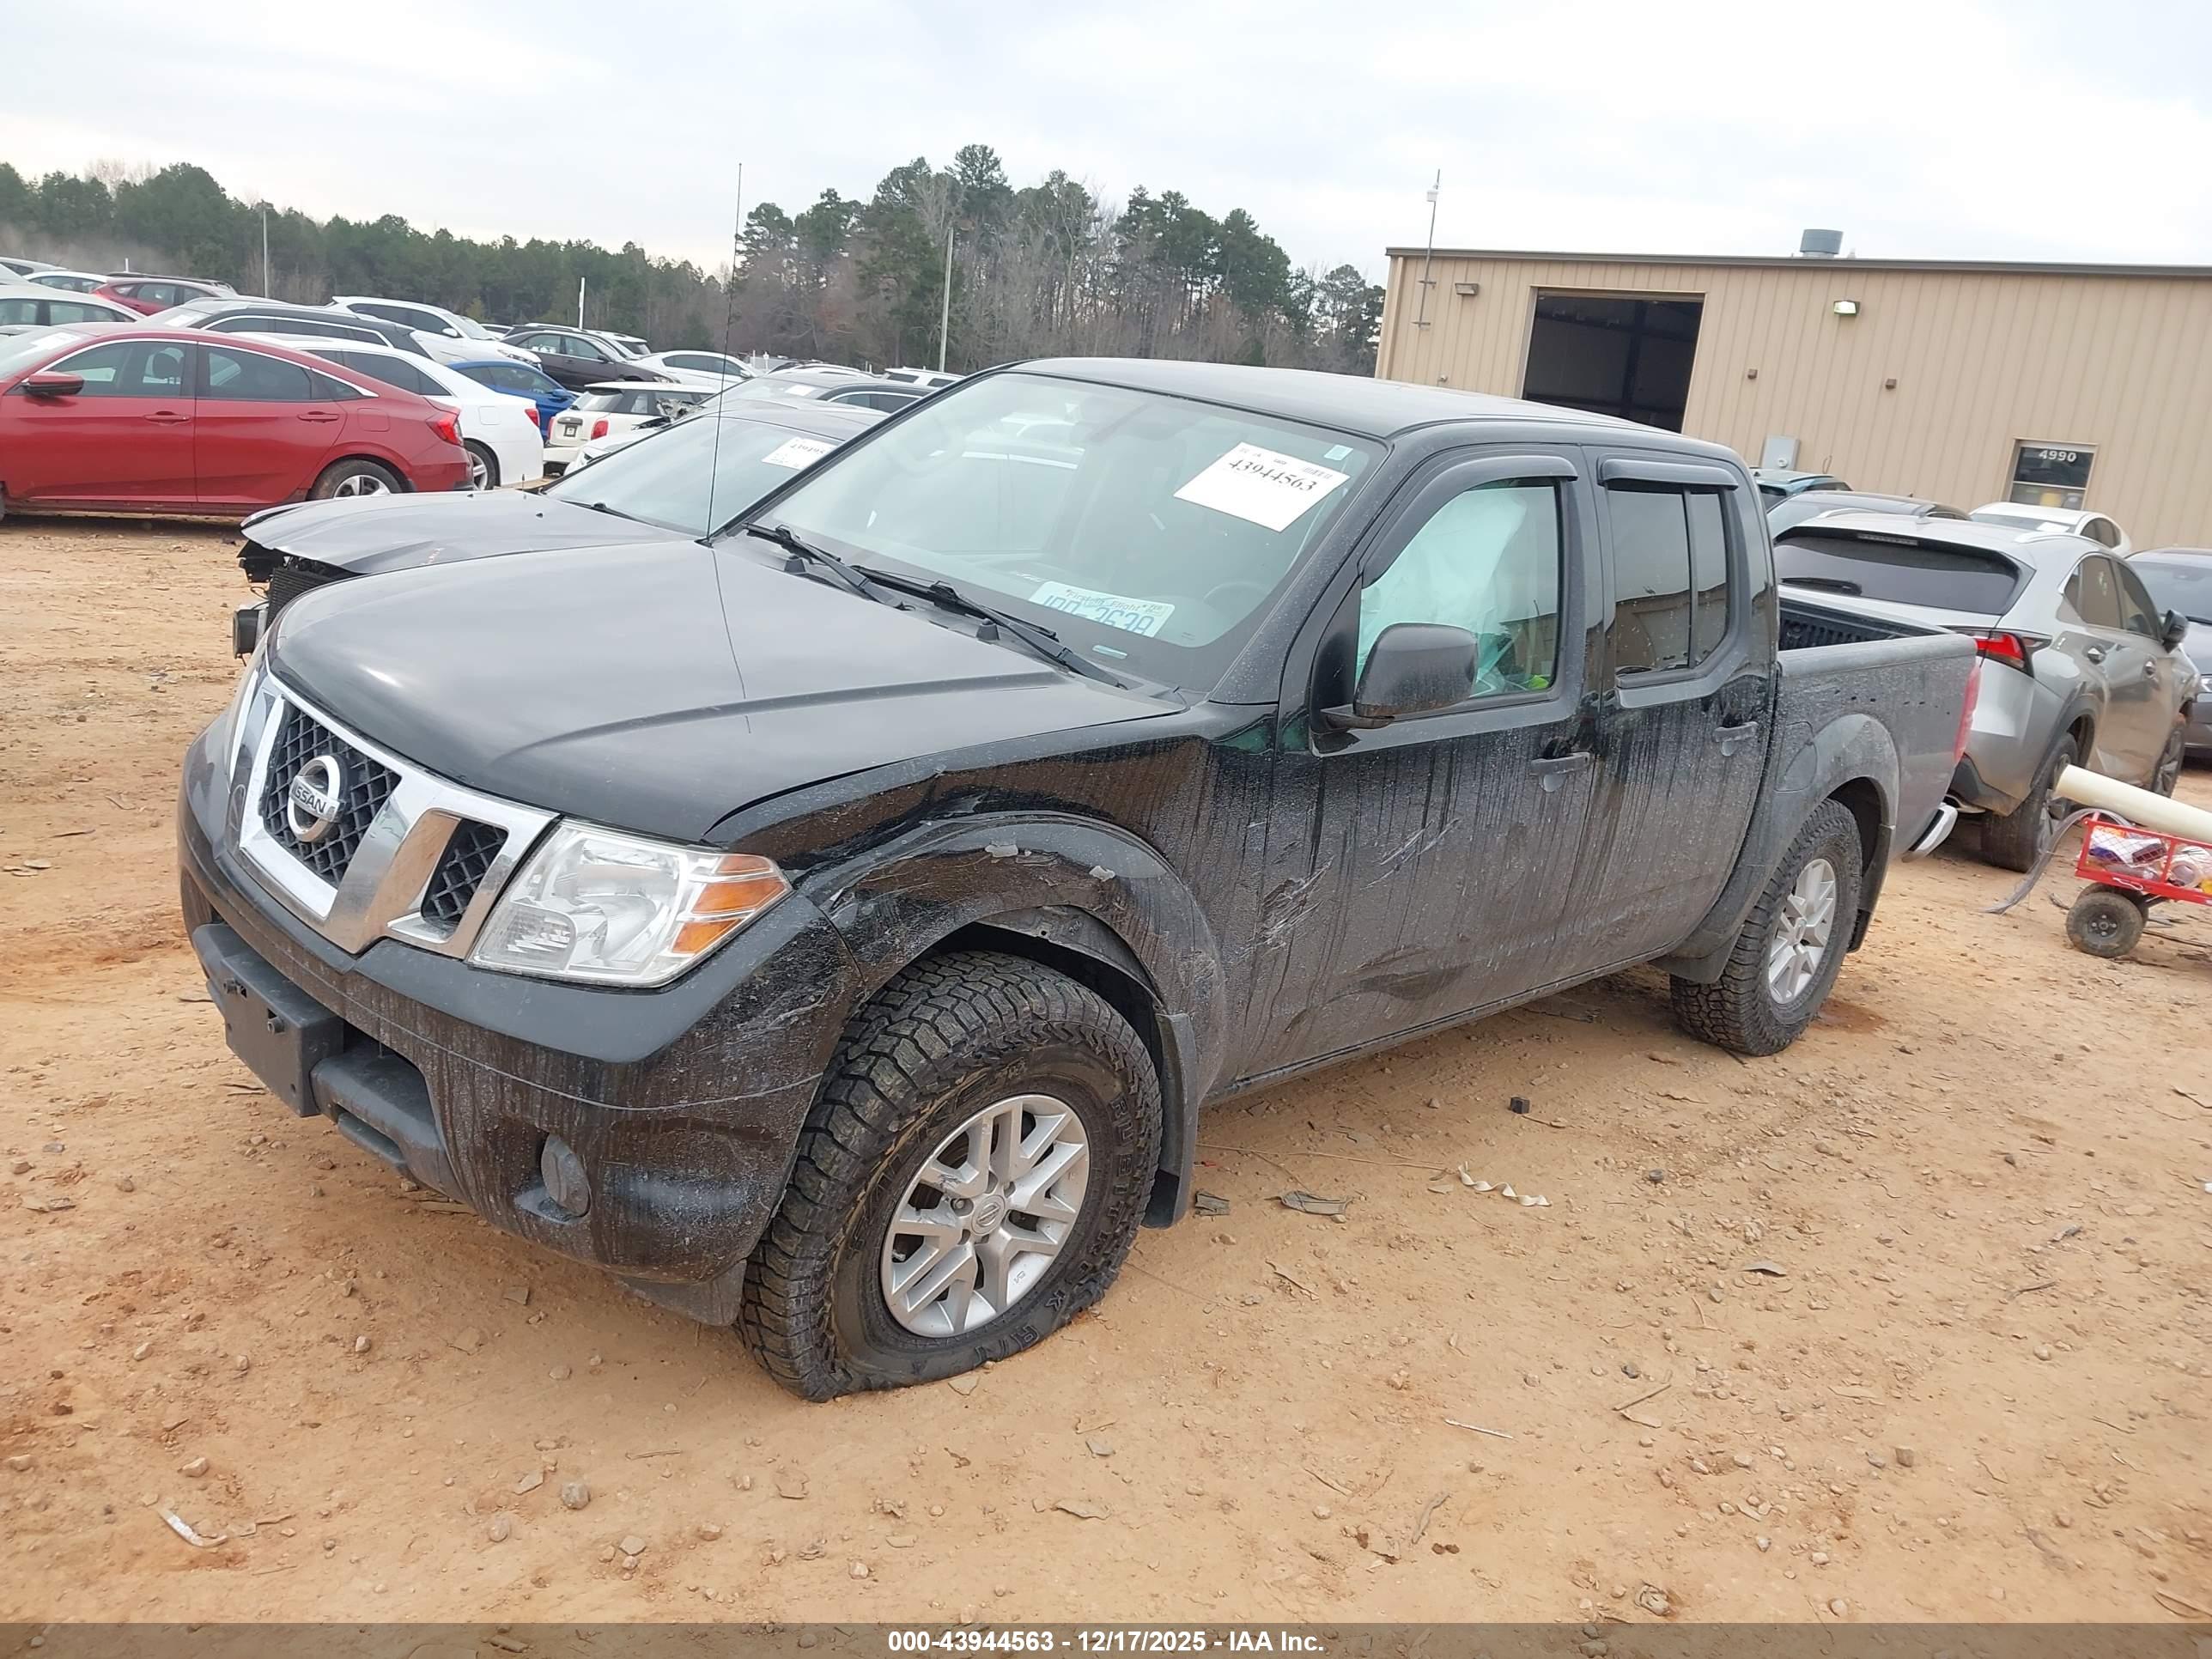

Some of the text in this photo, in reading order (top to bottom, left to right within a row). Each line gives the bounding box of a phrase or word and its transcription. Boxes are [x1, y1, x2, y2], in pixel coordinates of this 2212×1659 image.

[2039, 450, 2076, 462] 4990
[1229, 459, 1317, 491] 43944563
[292, 782, 326, 813] ISSAN
